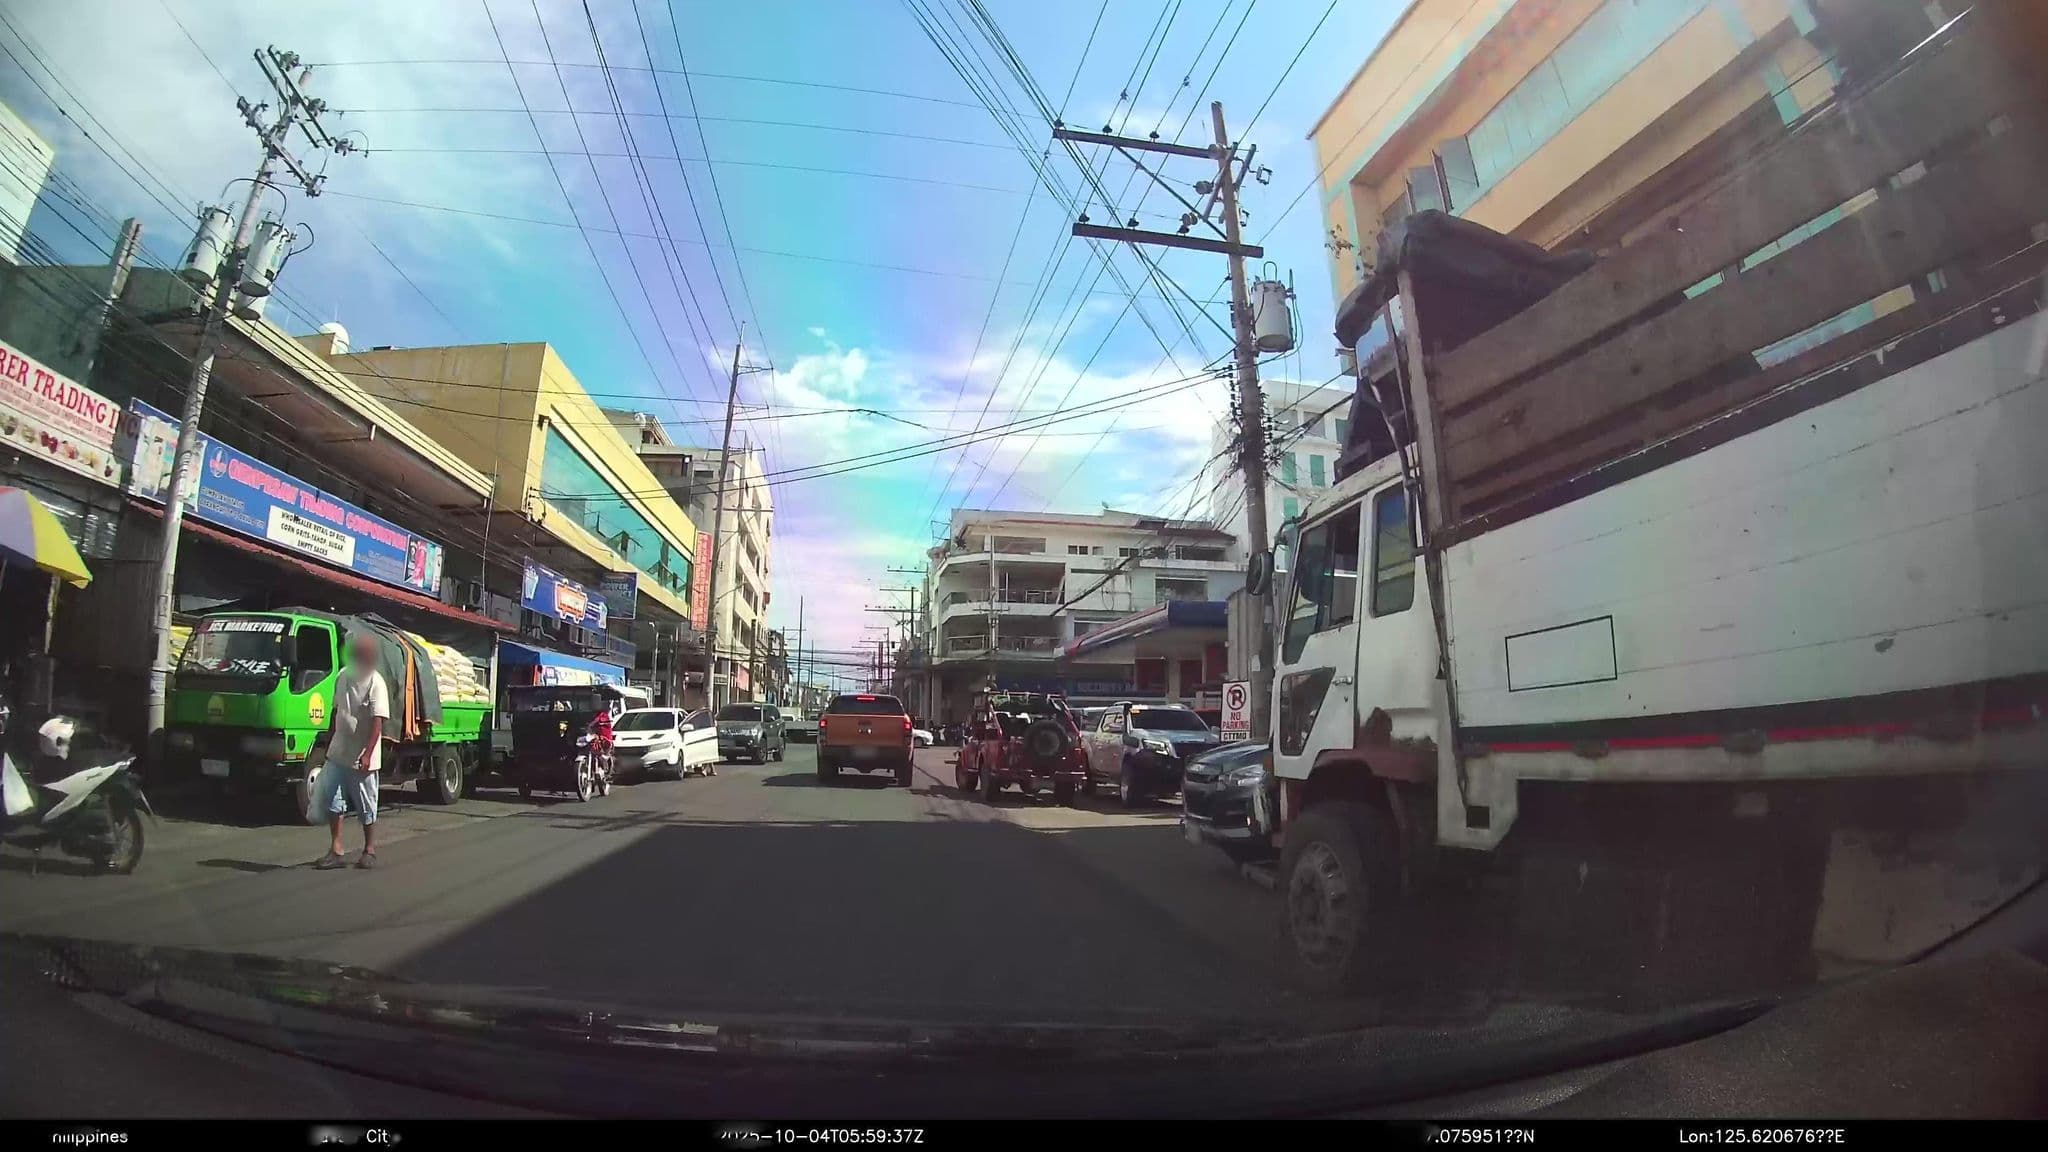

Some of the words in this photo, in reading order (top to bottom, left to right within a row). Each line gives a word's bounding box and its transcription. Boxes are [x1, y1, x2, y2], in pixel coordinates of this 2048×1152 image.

[33, 369, 107, 424] TRADING
[300, 490, 345, 525] TRADING
[281, 511, 313, 530] WHOSALER
[281, 522, 295, 533] CORN
[297, 540, 313, 551] EMPTY
[314, 545, 328, 556] SACKS
[224, 621, 285, 633] MARKETING
[1230, 711, 1242, 721] NO
[1222, 720, 1250, 730] PARKING
